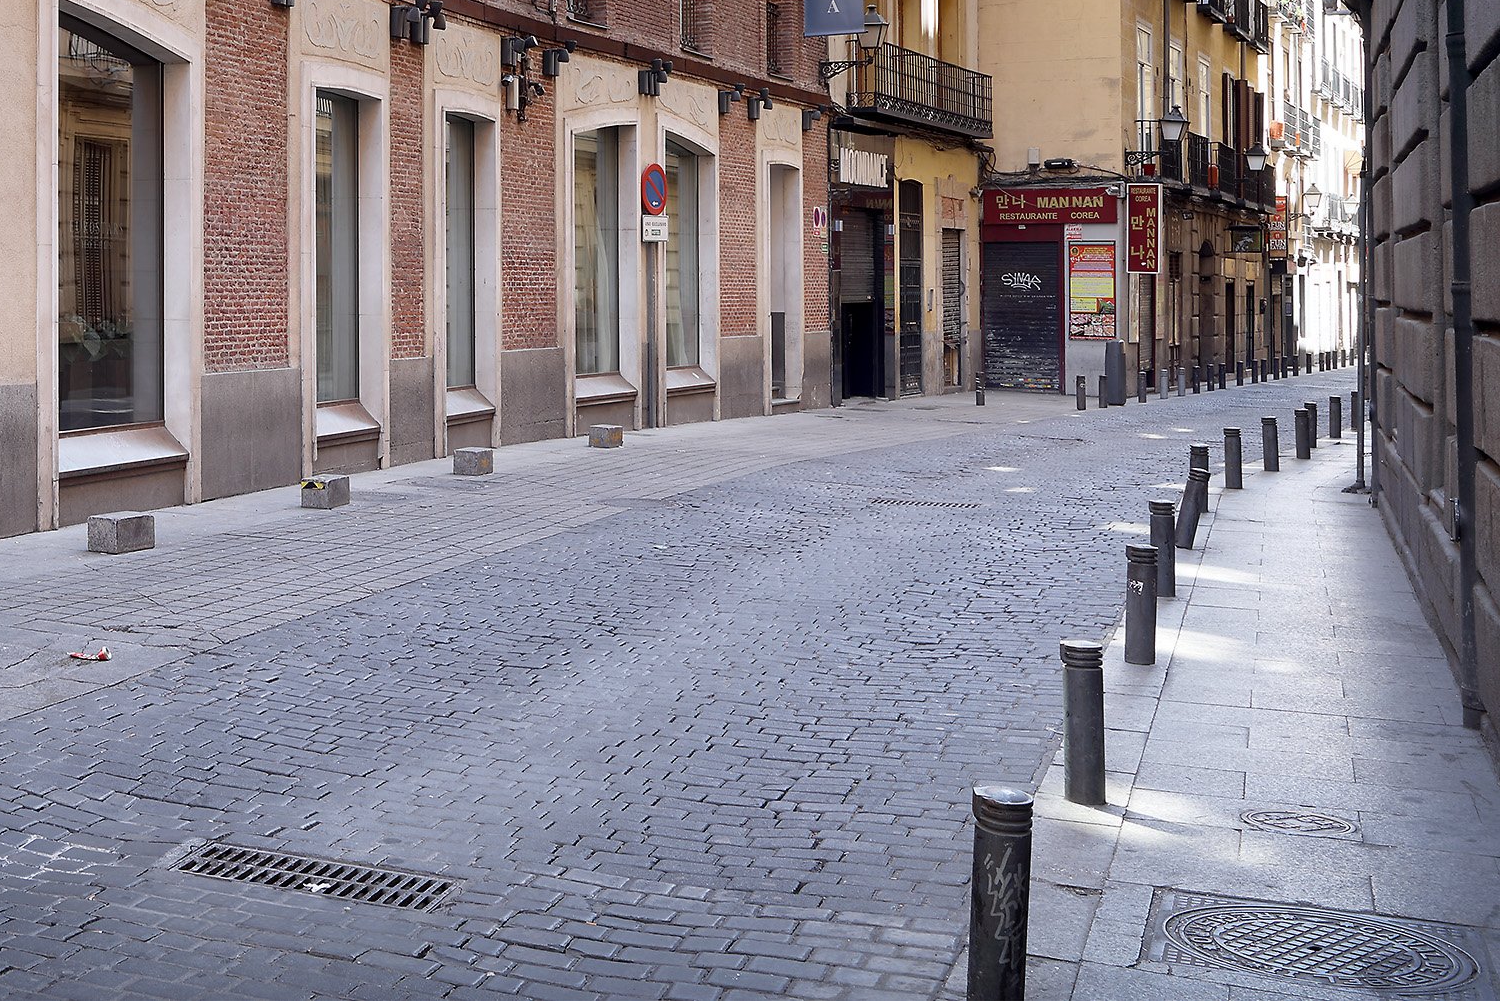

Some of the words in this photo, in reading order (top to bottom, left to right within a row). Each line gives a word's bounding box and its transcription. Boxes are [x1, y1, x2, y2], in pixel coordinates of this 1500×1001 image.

[840, 147, 889, 188] MOONDANCE
[1130, 187, 1156, 195] RESTAURANTE
[995, 194, 1026, 209] 만나
[1135, 195, 1151, 203] COREA
[999, 212, 1058, 220] RESTAURANTE
[1070, 211, 1100, 219] COREA
[1270, 239, 1287, 247] FUN
